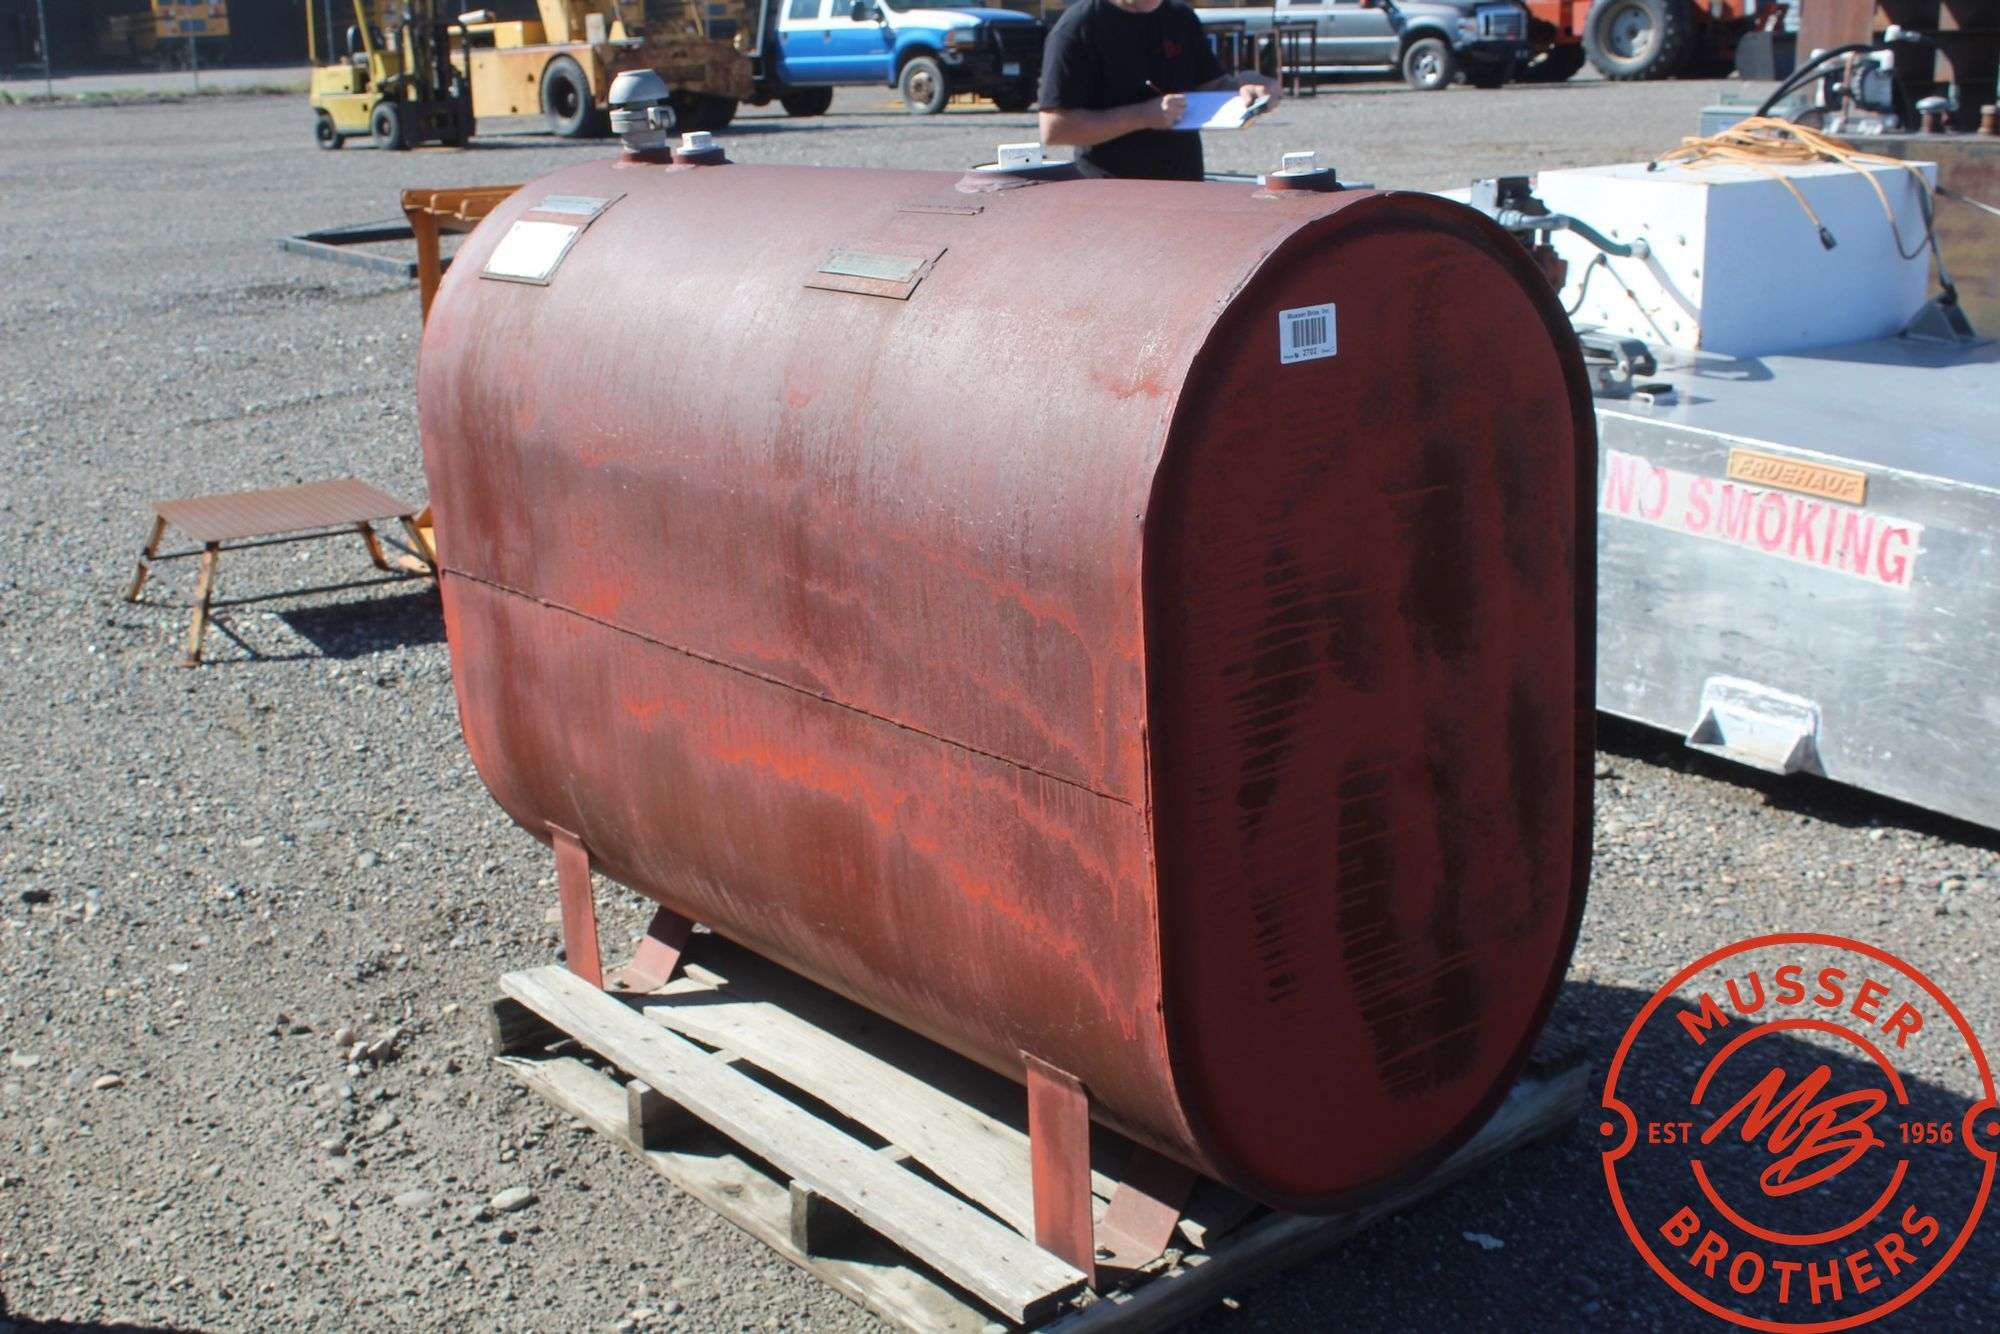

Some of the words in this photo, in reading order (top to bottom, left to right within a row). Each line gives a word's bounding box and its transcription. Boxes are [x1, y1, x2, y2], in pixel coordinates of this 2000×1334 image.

[1604, 454, 1669, 520] NO
[1684, 475, 1910, 585] SMOKING
[1739, 459, 1858, 496] FRUEHAUF
